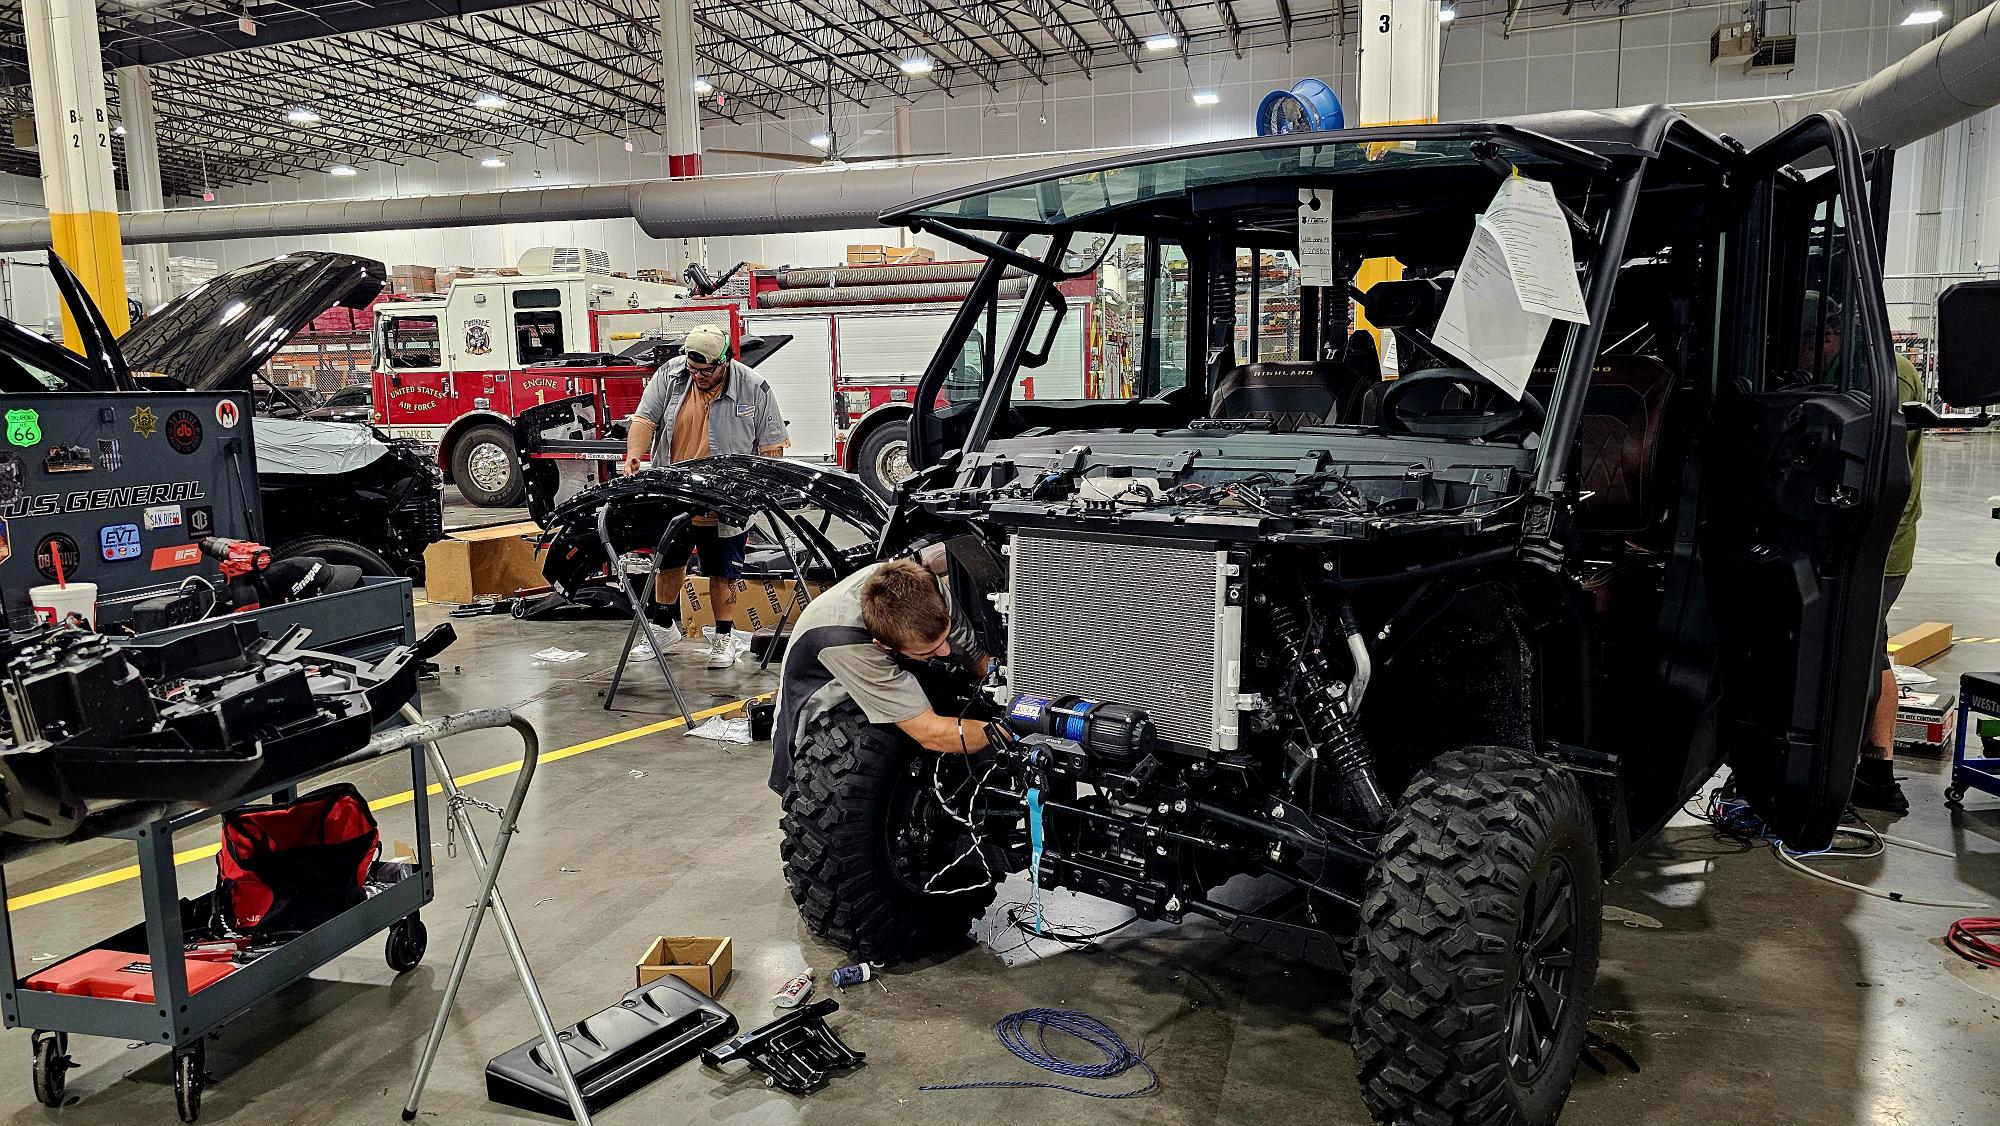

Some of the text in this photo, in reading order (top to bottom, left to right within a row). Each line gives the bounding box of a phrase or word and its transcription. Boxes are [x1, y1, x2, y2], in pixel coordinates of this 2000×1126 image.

[1379, 15, 1390, 33] 3
[69, 109, 77, 123] B
[96, 108, 104, 122] B
[73, 134, 80, 147] 2
[98, 133, 106, 147] 2
[522, 378, 557, 389] ENGINE
[1019, 376, 1035, 400] 1
[390, 386, 443, 399] UNITED STATES
[534, 389, 545, 405] 1
[398, 400, 437, 411] AIR FORCE
[14, 427, 35, 441] 66
[397, 430, 434, 439] TINKER
[65, 480, 206, 513] GENERAL
[150, 513, 164, 526] SAN
[105, 529, 136, 545] EVT
[38, 551, 79, 569] DB RIVE
